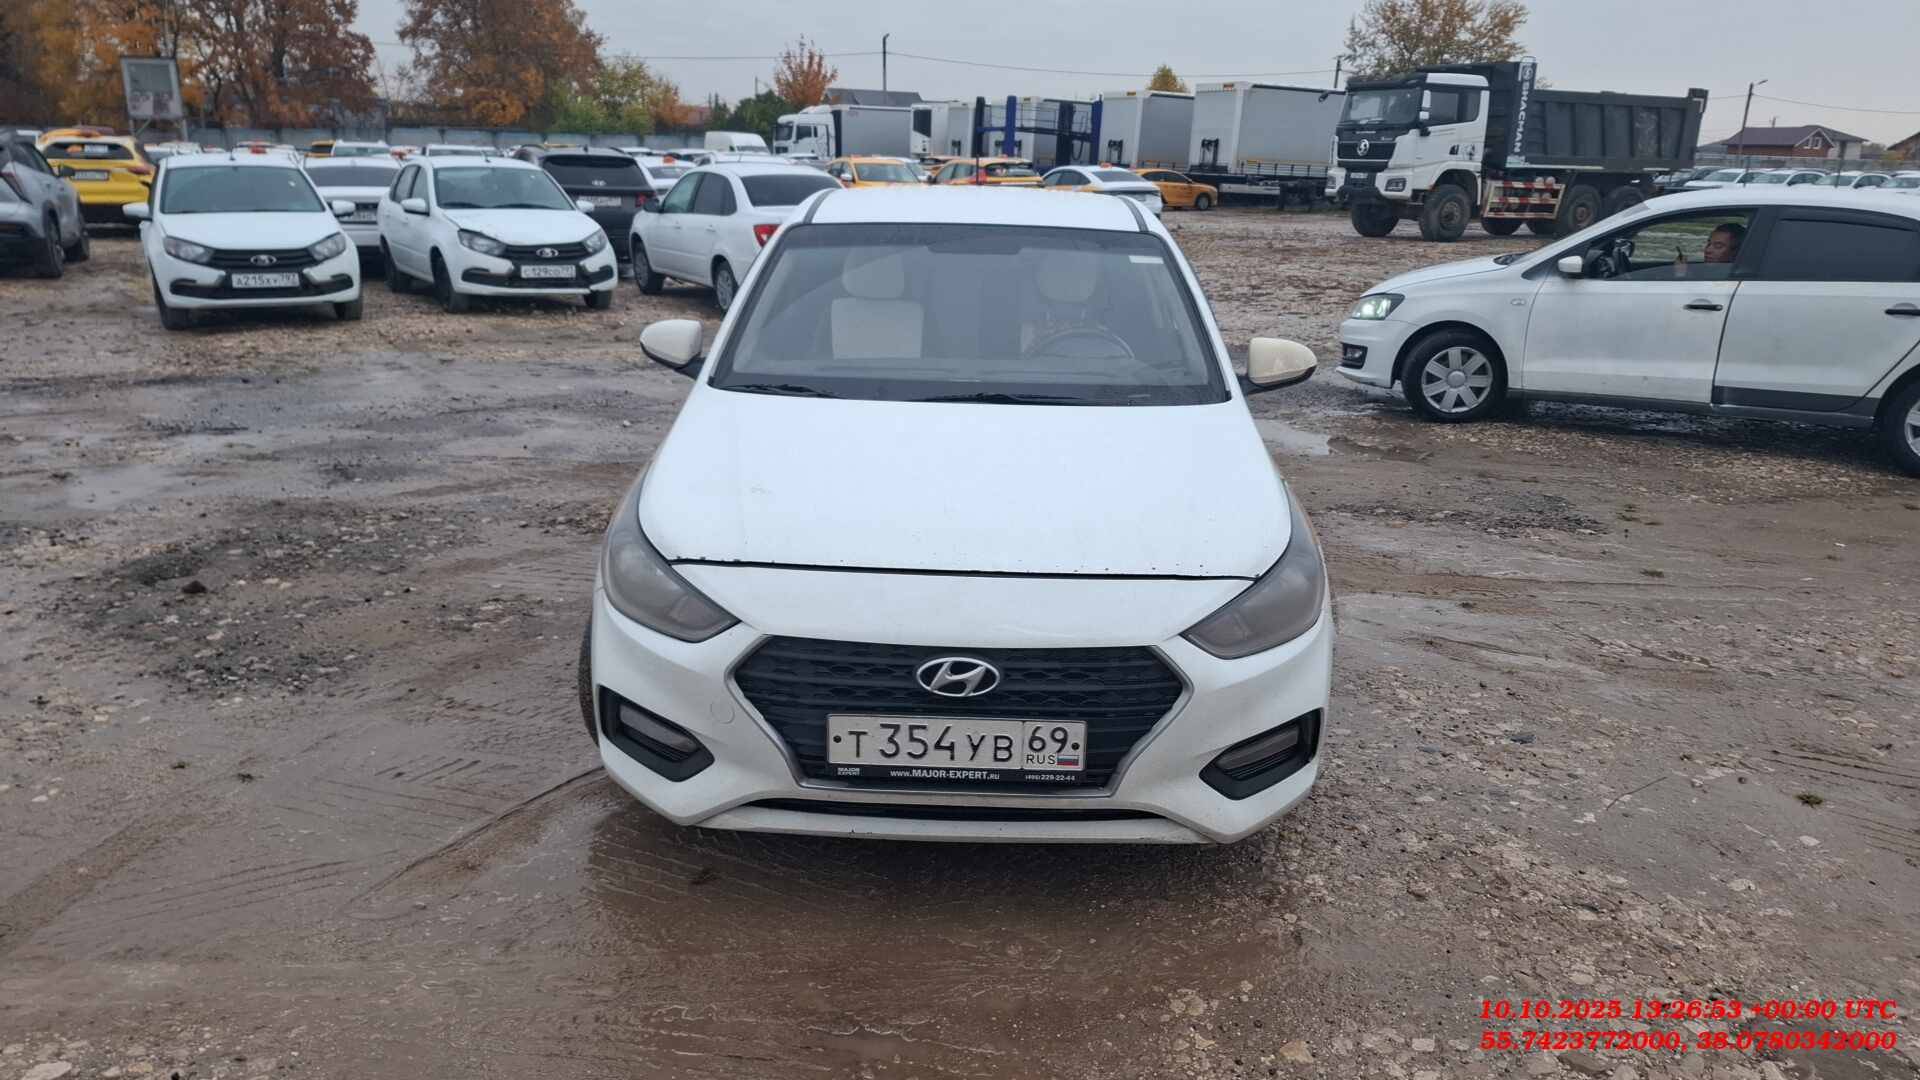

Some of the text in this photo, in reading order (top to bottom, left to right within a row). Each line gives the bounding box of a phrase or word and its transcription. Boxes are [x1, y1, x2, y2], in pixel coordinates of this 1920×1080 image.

[1513, 81, 1530, 152] SHACMAN
[1028, 726, 1068, 753] 69
[1025, 754, 1056, 764] RUS
